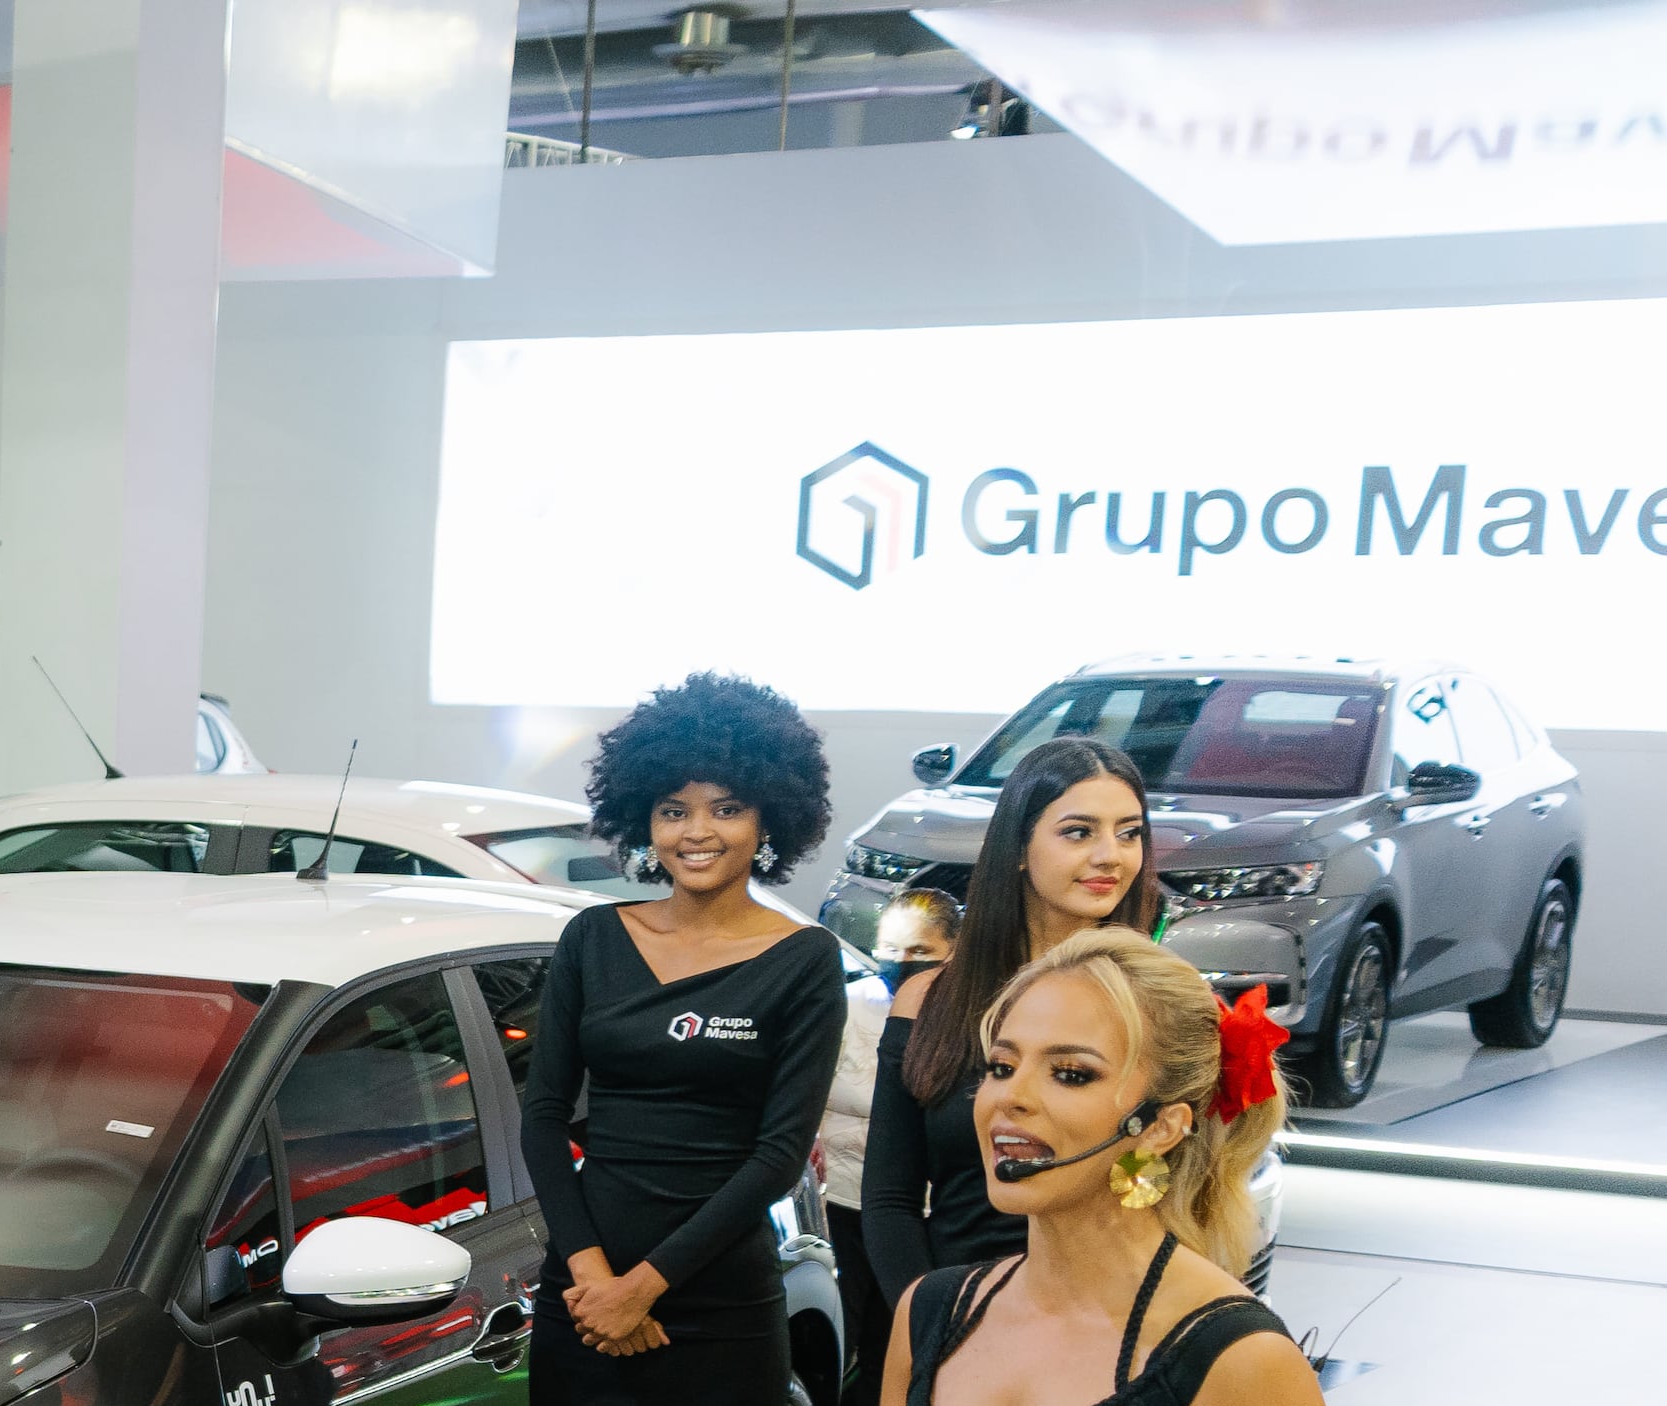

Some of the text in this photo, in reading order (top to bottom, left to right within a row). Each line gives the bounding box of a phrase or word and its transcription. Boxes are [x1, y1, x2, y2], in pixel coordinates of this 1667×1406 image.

[961, 467, 1330, 577] Grupo
[708, 1016, 753, 1029] Grupo
[704, 1027, 758, 1040] Mavesa
